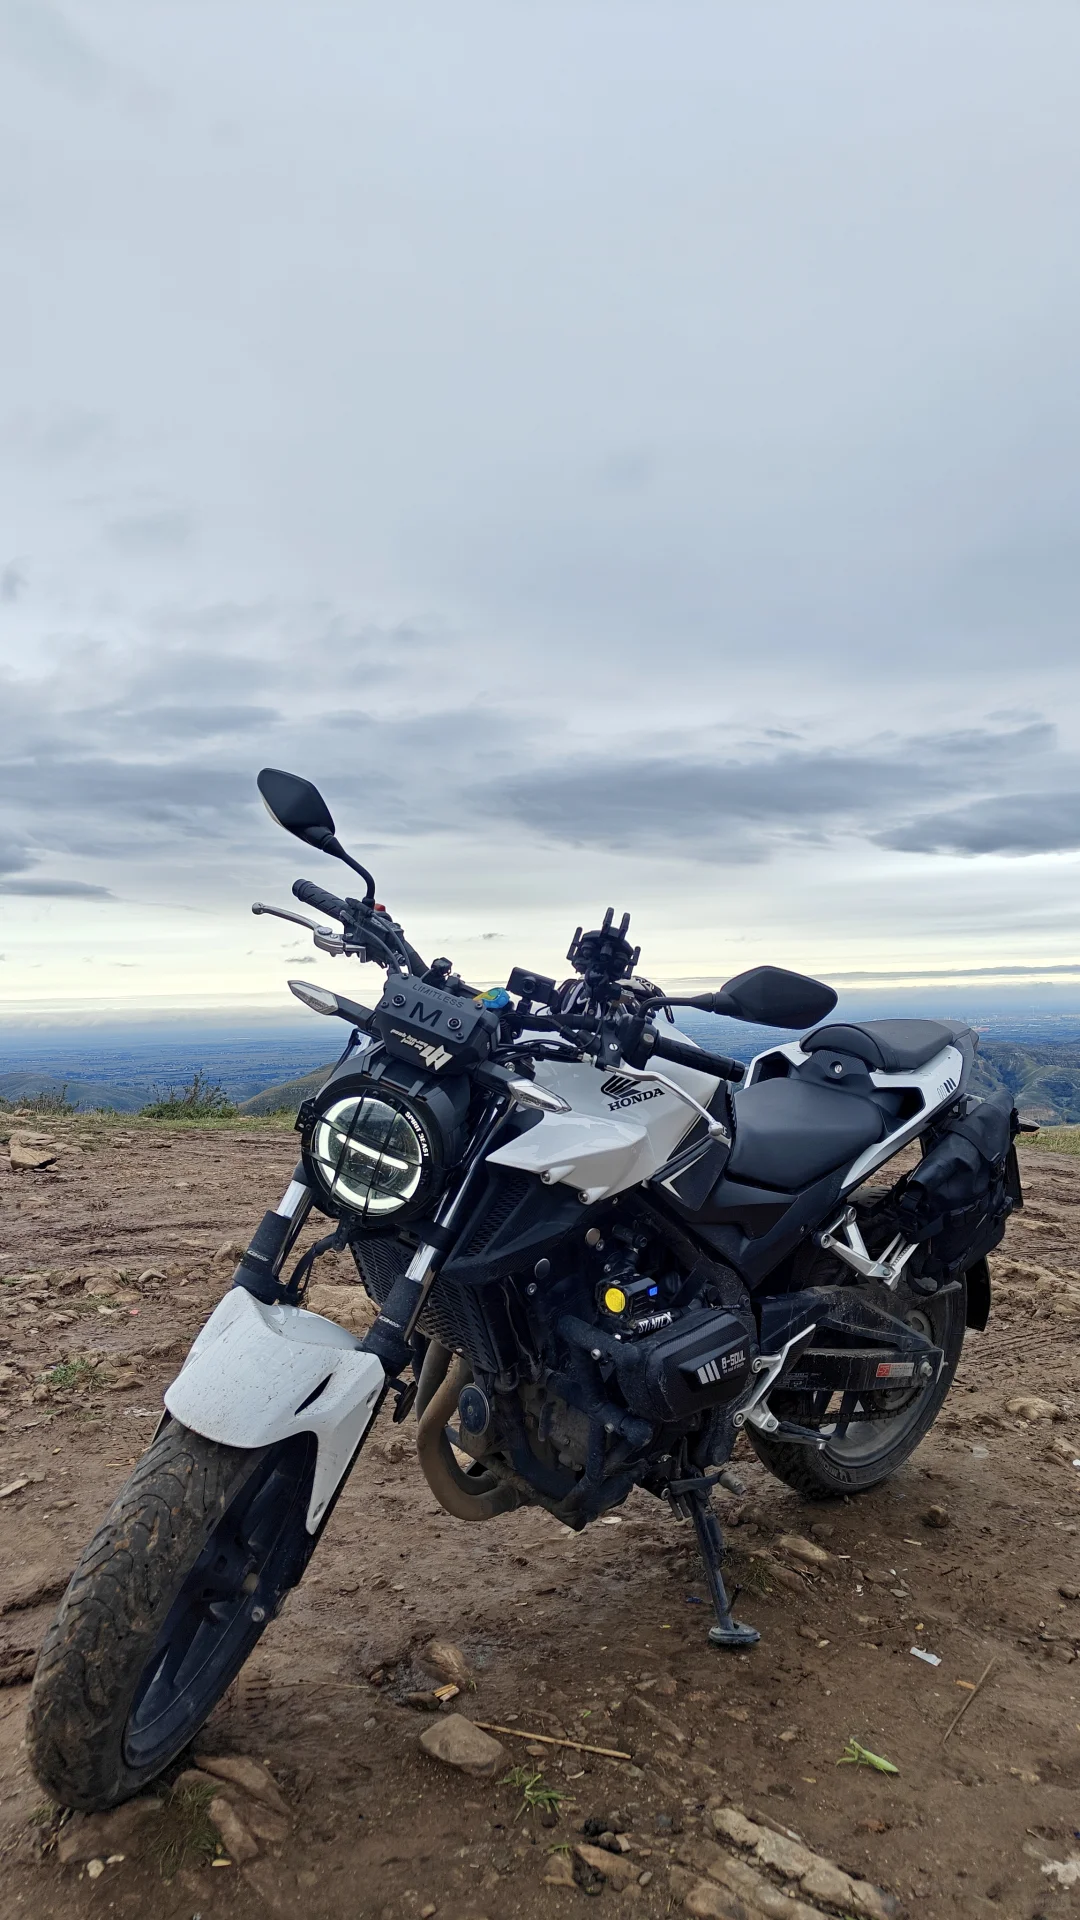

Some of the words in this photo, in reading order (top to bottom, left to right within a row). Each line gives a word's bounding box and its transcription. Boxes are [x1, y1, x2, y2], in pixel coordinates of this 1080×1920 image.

[412, 983, 465, 1008] LIMITLESS
[408, 1001, 443, 1028] M
[607, 1087, 666, 1112] HONDA
[404, 1111, 421, 1132] SPIRIT
[418, 1132, 430, 1157] BEAST
[721, 1349, 746, 1370] B-SOUL
